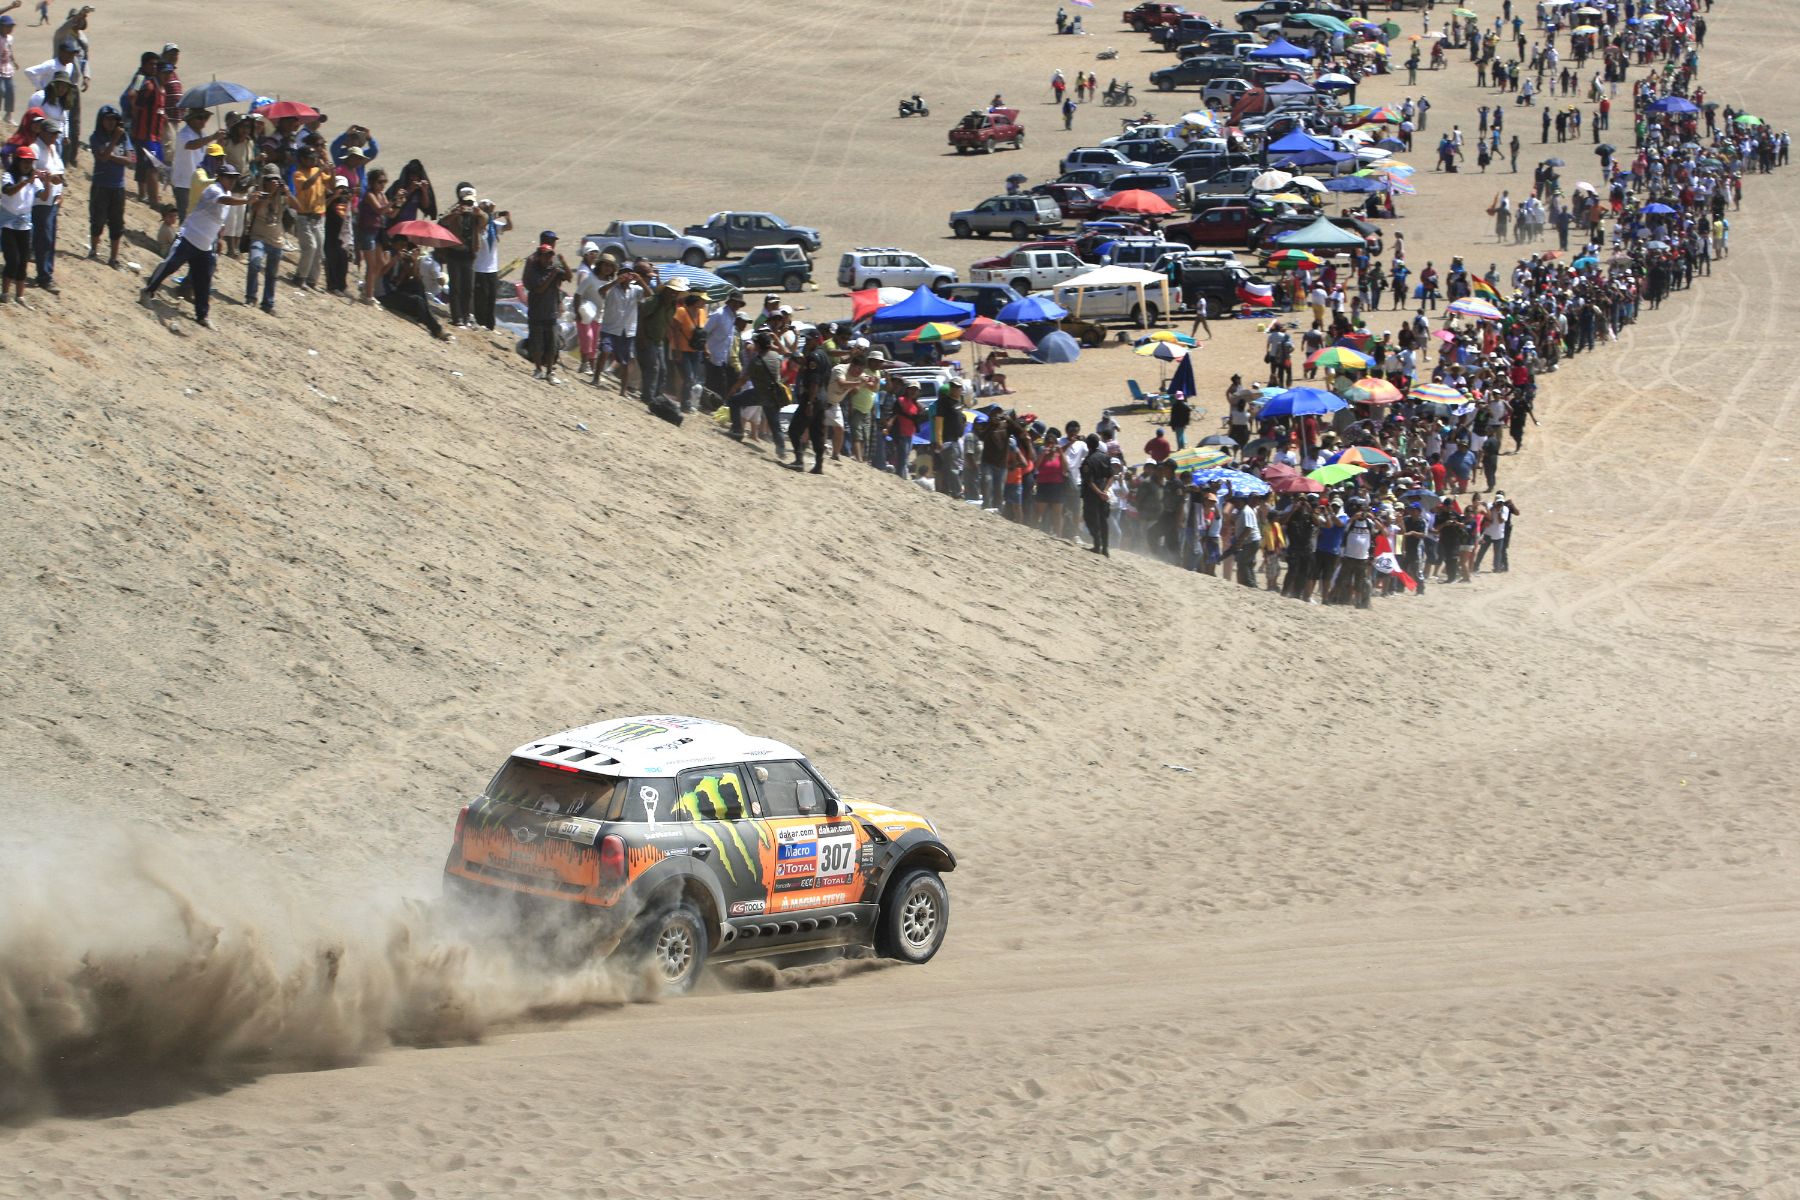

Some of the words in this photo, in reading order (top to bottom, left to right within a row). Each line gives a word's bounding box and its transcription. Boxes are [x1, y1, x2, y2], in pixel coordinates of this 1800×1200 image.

[562, 824, 579, 834] 307
[779, 829, 814, 839] dakar.com
[818, 824, 852, 835] dakar.com
[785, 844, 810, 857] Macro
[821, 843, 852, 872] 307
[785, 862, 815, 873] TOTAL
[823, 877, 845, 885] TOTAL
[791, 896, 820, 908] MAGNA
[822, 892, 846, 904] STEYR
